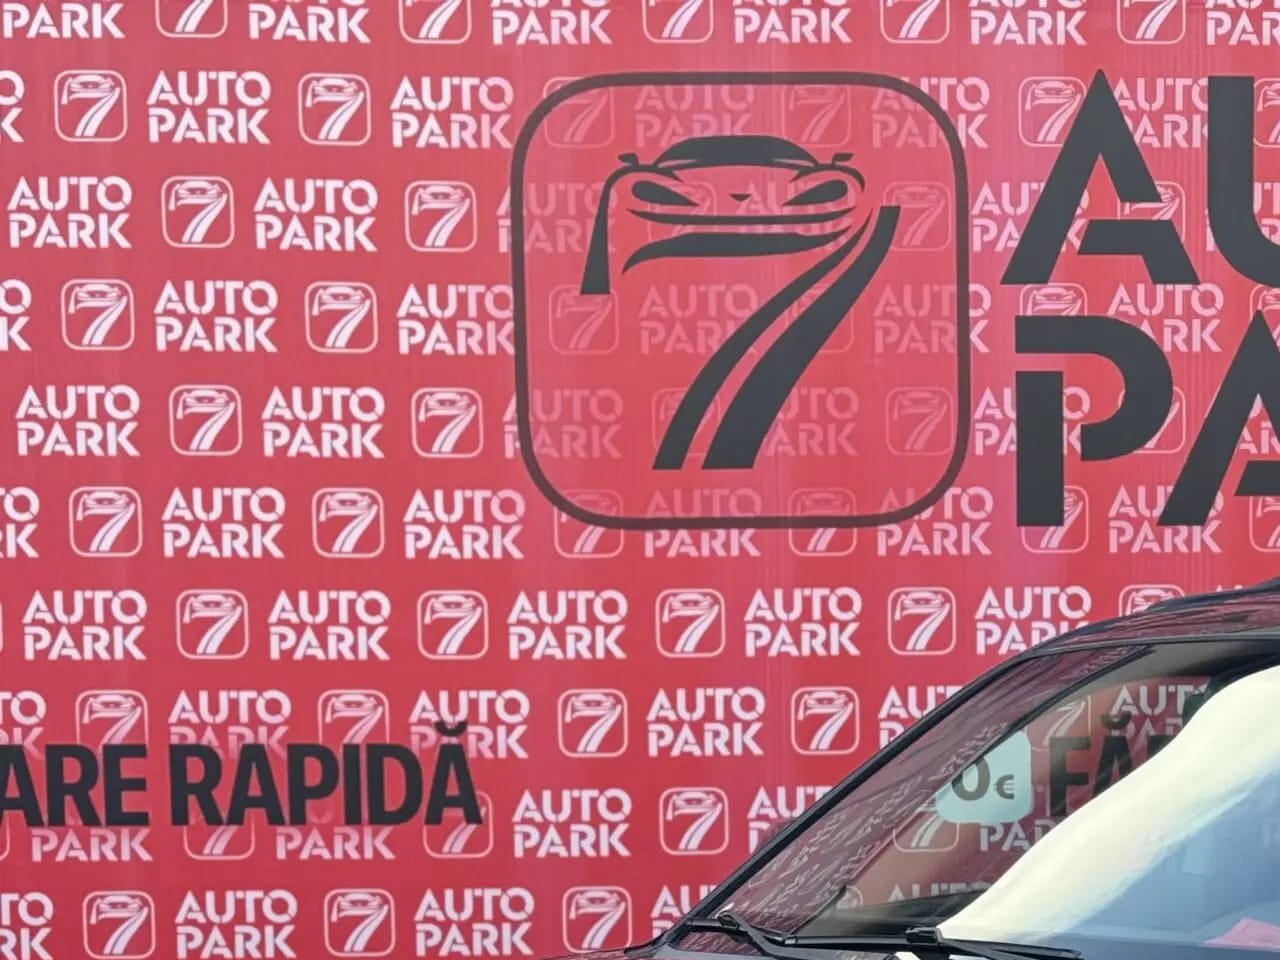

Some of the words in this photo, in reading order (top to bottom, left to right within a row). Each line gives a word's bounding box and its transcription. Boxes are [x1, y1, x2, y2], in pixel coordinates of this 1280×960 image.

[3, 2, 125, 38] PARK
[249, 3, 371, 43] PARK
[492, 9, 612, 45] PARK
[734, 8, 852, 43] PARK
[971, 9, 1086, 45] PARK
[147, 71, 271, 107] AUTO
[390, 76, 513, 111] AUTO
[149, 107, 270, 144] PARK
[392, 112, 512, 148] PARK
[9, 176, 132, 211] AUTO
[254, 178, 378, 215] AUTO
[9, 213, 131, 248] PARK
[255, 214, 377, 252] PARK
[154, 280, 278, 315] AUTO
[397, 284, 513, 319] AUTO
[639, 284, 757, 319] AUTO
[1107, 283, 1223, 316] AUTO
[156, 316, 277, 352] PARK
[398, 319, 514, 355] PARK
[16, 385, 140, 420] AUTO
[261, 386, 385, 422] AUTO
[17, 421, 139, 456] PARK
[263, 422, 384, 458] PARK
[766, 423, 858, 456] ARK
[162, 487, 285, 522] AUTO
[403, 489, 525, 523] AUTO
[164, 523, 284, 558] PARK
[405, 524, 523, 559] PARK
[645, 524, 761, 557] PARK
[877, 521, 991, 555] PARK
[1110, 520, 1221, 552] PARK
[23, 590, 147, 624] AUTO
[268, 590, 391, 625] AUTO
[508, 590, 627, 624] AUTO
[744, 587, 862, 621] AUTO
[975, 586, 1091, 619] AUTO
[24, 626, 146, 660] PARK
[270, 626, 389, 660] PARK
[509, 625, 626, 659] PARK
[746, 622, 860, 657] PARK
[169, 690, 291, 723] AUTO
[410, 690, 530, 723] AUTO
[647, 687, 765, 721] AUTO
[648, 722, 763, 756] PARK
[169, 720, 483, 827] RAPIDĂ
[512, 789, 631, 822] AUTO
[33, 830, 152, 861] PARK
[277, 829, 394, 859] PARK
[514, 824, 630, 857] PARK
[176, 890, 297, 923] AUTO
[415, 888, 534, 921] AUTO
[177, 925, 296, 958] PARK
[416, 923, 532, 956] PARK
